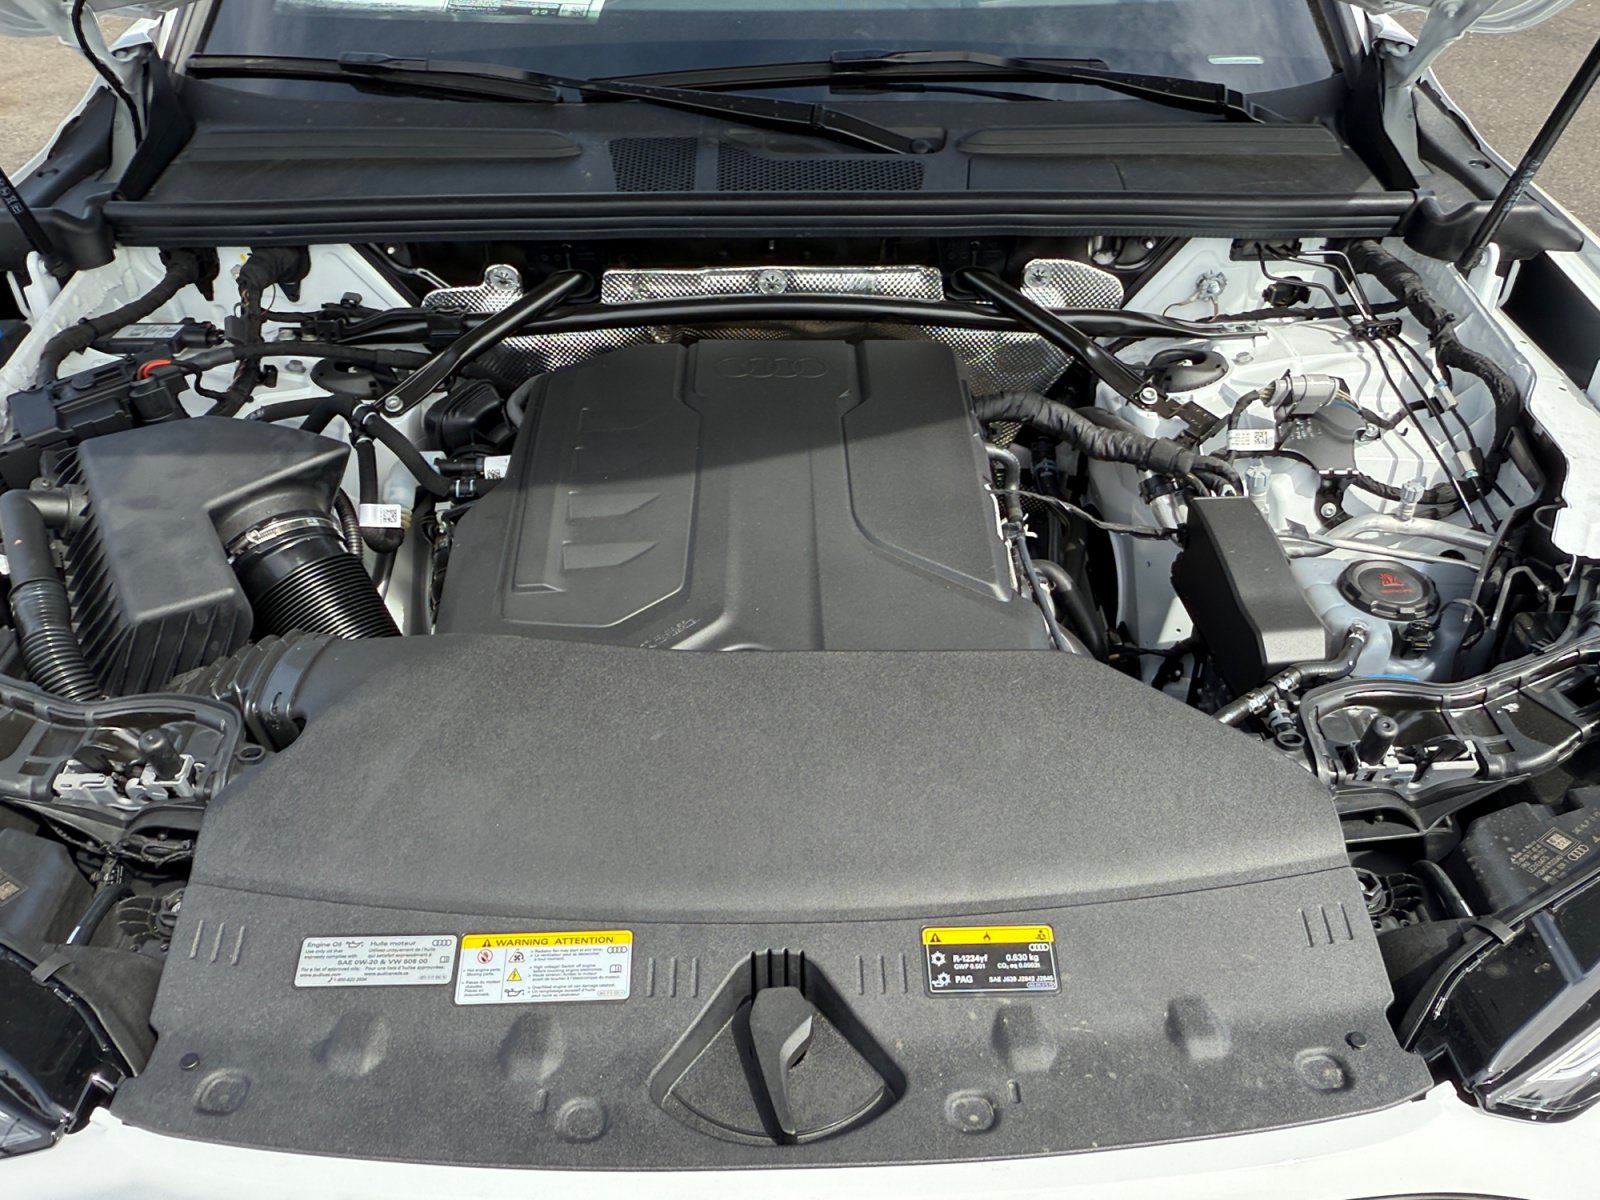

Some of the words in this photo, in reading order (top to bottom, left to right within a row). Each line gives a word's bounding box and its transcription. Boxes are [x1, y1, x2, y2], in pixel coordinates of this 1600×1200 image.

[495, 938, 549, 947] WARNING
[554, 936, 614, 945] ATTENTION
[952, 954, 988, 963] R-1234yf
[1005, 954, 1028, 962] 0.630
[1029, 953, 1039, 962] kg
[955, 974, 973, 984] PAG
